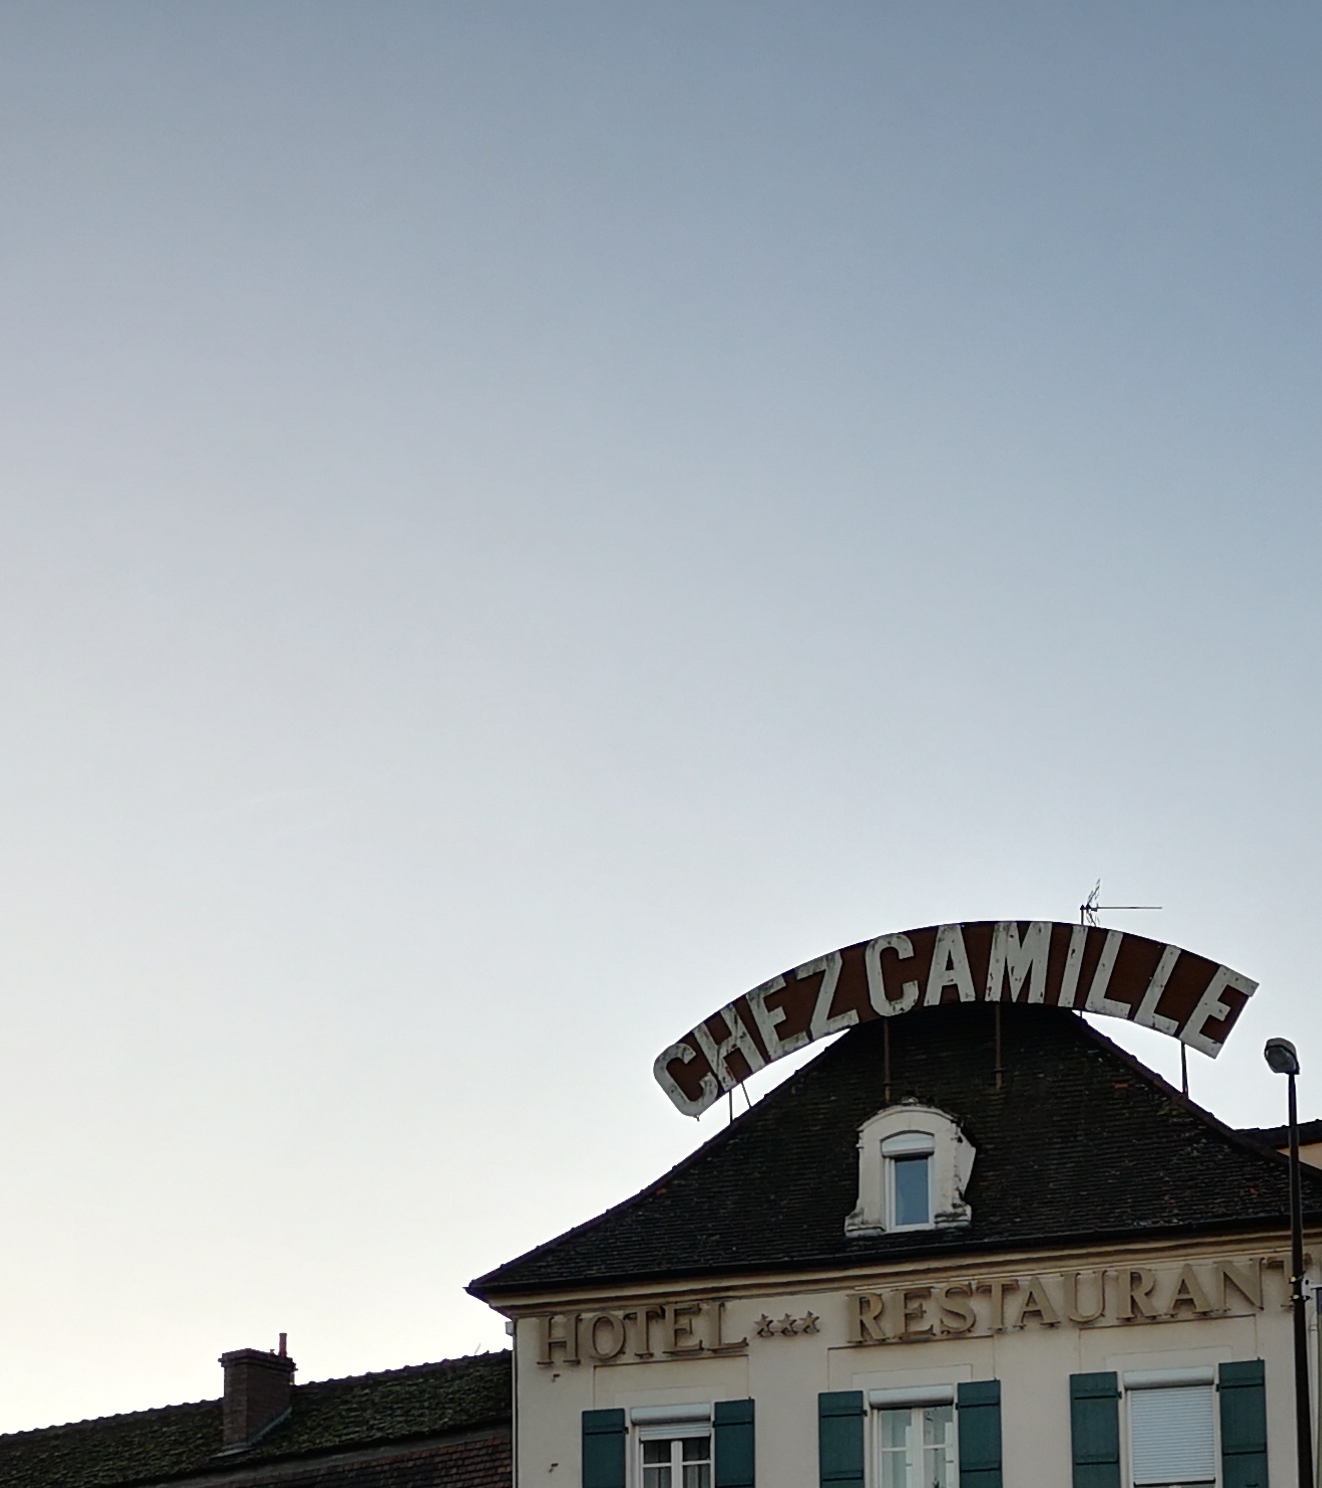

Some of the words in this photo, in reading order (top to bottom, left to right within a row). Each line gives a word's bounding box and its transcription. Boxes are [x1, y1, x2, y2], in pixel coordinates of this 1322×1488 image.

[653, 950, 860, 1118] CHEZ
[865, 921, 1260, 1060] CAMILLE
[536, 1300, 750, 1365] HOTEL
[846, 1253, 1313, 1347] RESTAURANT
